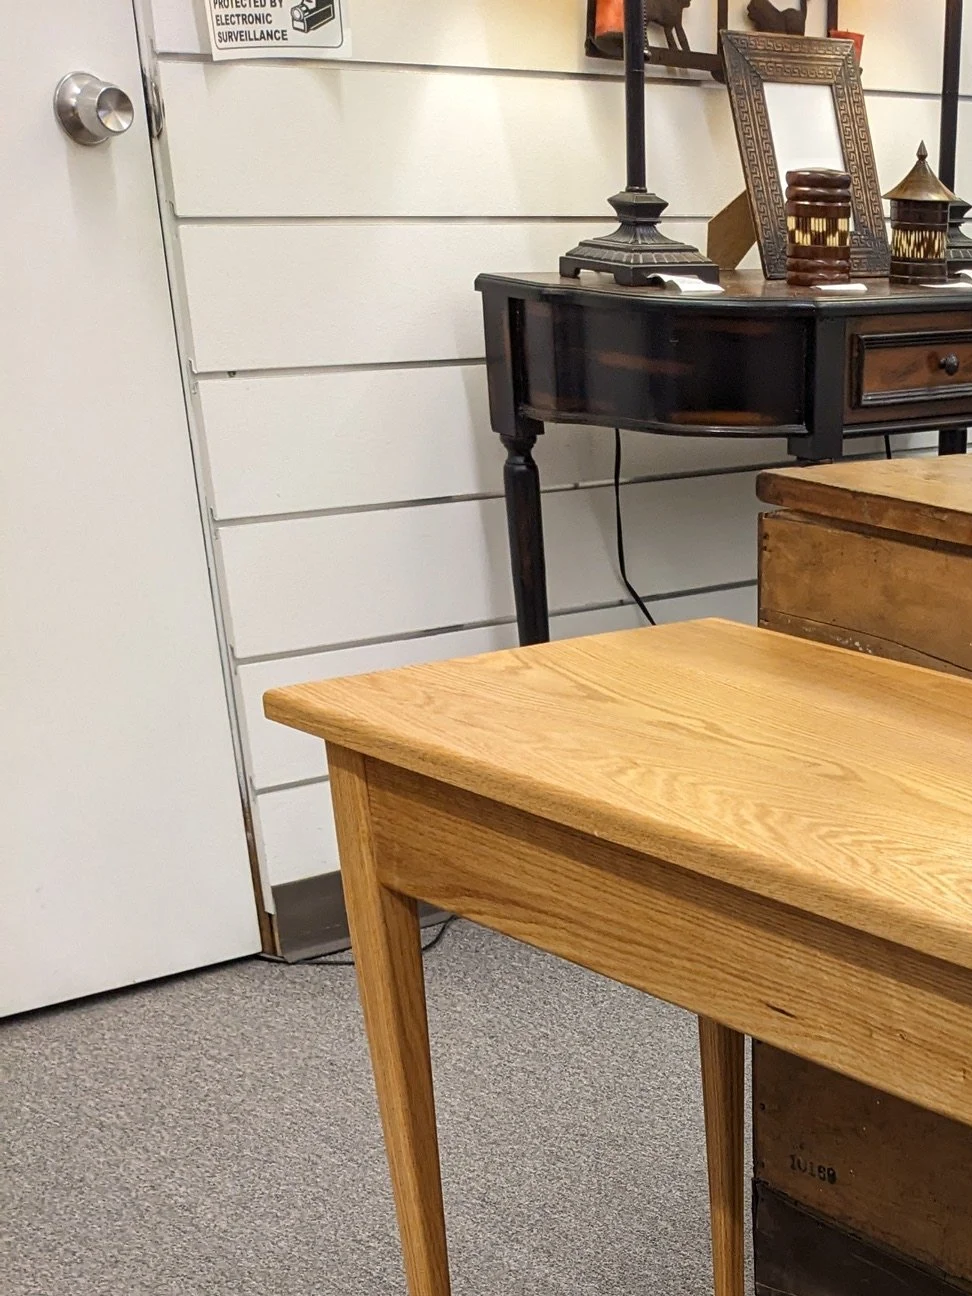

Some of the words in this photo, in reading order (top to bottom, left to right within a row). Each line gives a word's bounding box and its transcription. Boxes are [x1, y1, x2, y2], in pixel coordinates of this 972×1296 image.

[213, 0, 267, 9] PROTECTED
[270, 0, 283, 8] BY
[215, 13, 273, 26] ELECTRONIC
[217, 29, 288, 43] SURVEILLANCE
